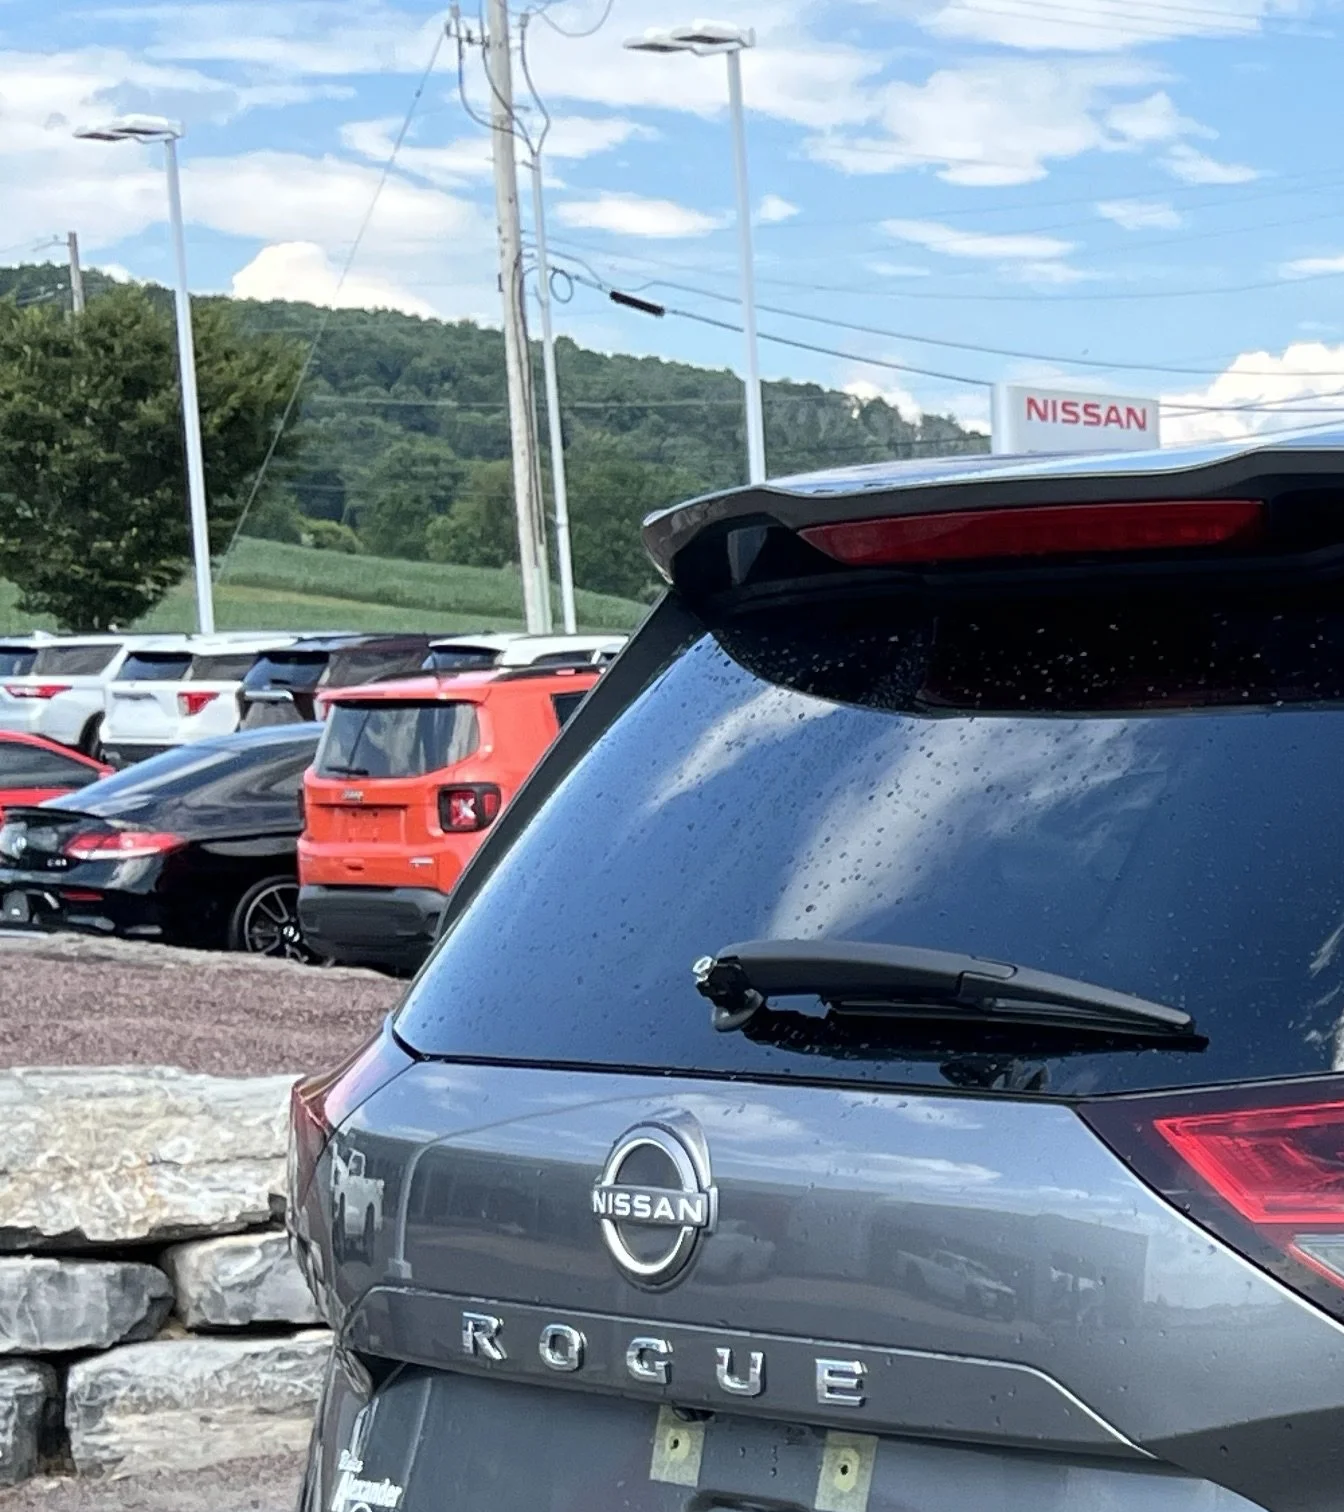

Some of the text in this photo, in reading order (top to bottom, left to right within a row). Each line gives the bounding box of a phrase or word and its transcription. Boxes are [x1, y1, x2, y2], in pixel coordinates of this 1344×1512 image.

[1026, 396, 1148, 431] NISSAN
[592, 1190, 702, 1222] NISSAN
[462, 1311, 866, 1407] ROGUE
